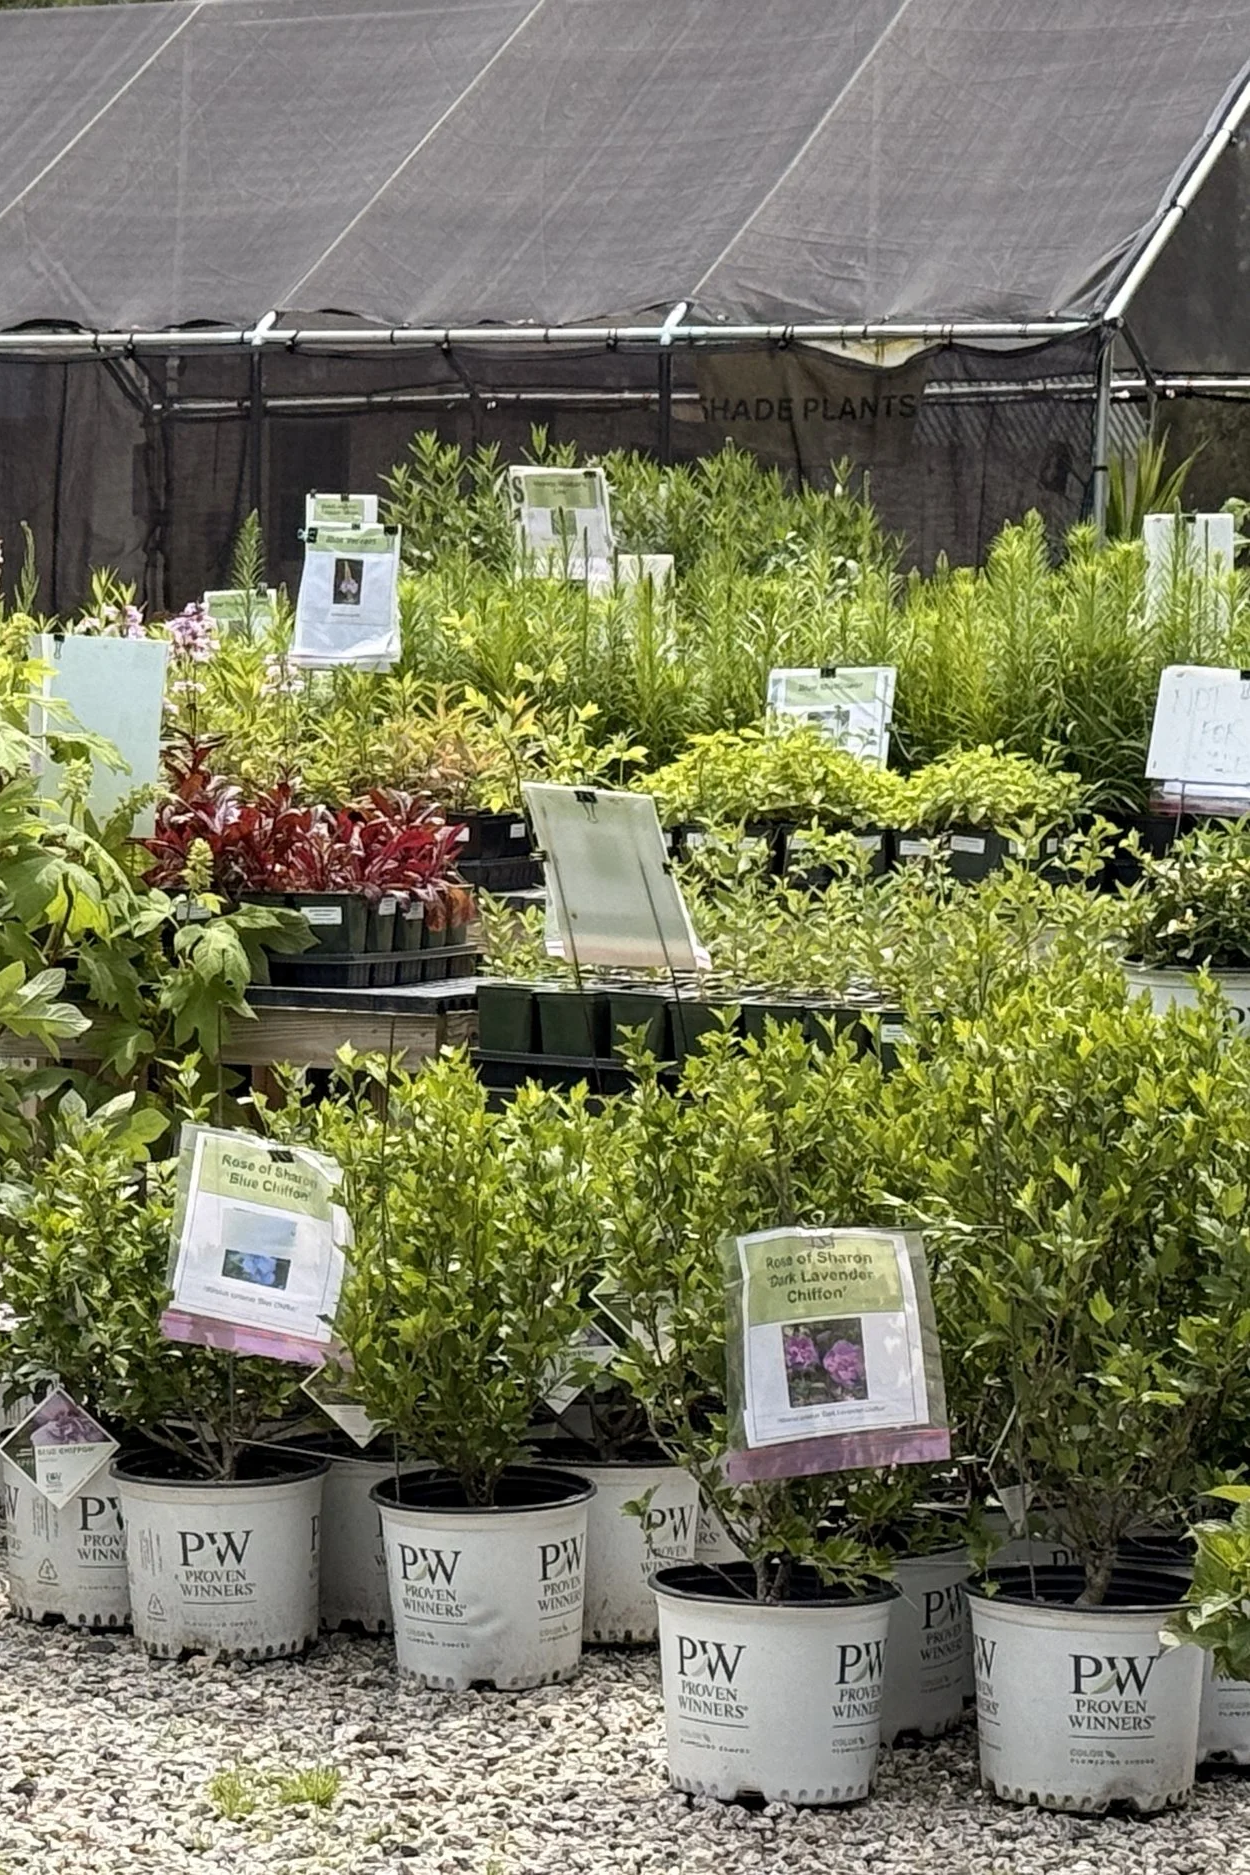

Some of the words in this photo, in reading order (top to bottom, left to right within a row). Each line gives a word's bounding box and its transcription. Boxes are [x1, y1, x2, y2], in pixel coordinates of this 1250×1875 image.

[803, 394, 917, 421] PLANTS
[221, 1153, 256, 1172] Rose
[258, 1163, 272, 1176] of
[766, 1255, 793, 1270] Rose
[796, 1252, 813, 1265] of
[817, 1251, 873, 1265] Sharon
[801, 1268, 874, 1283] Lavender
[177, 1530, 253, 1567] PW
[537, 1532, 584, 1582] PW
[398, 1543, 462, 1585] PW
[185, 1569, 247, 1583] PROVEN
[180, 1582, 253, 1597] WINNERS
[405, 1583, 457, 1602] PROVEN
[402, 1598, 464, 1618] WINNERS
[676, 1635, 746, 1684] PW
[834, 1638, 888, 1685] PW
[1068, 1654, 1157, 1696] PW
[681, 1680, 737, 1701] PROVEN
[678, 1696, 746, 1719] WINNERS
[1076, 1699, 1147, 1714] PROVEN
[1069, 1715, 1152, 1731] WINNERS
